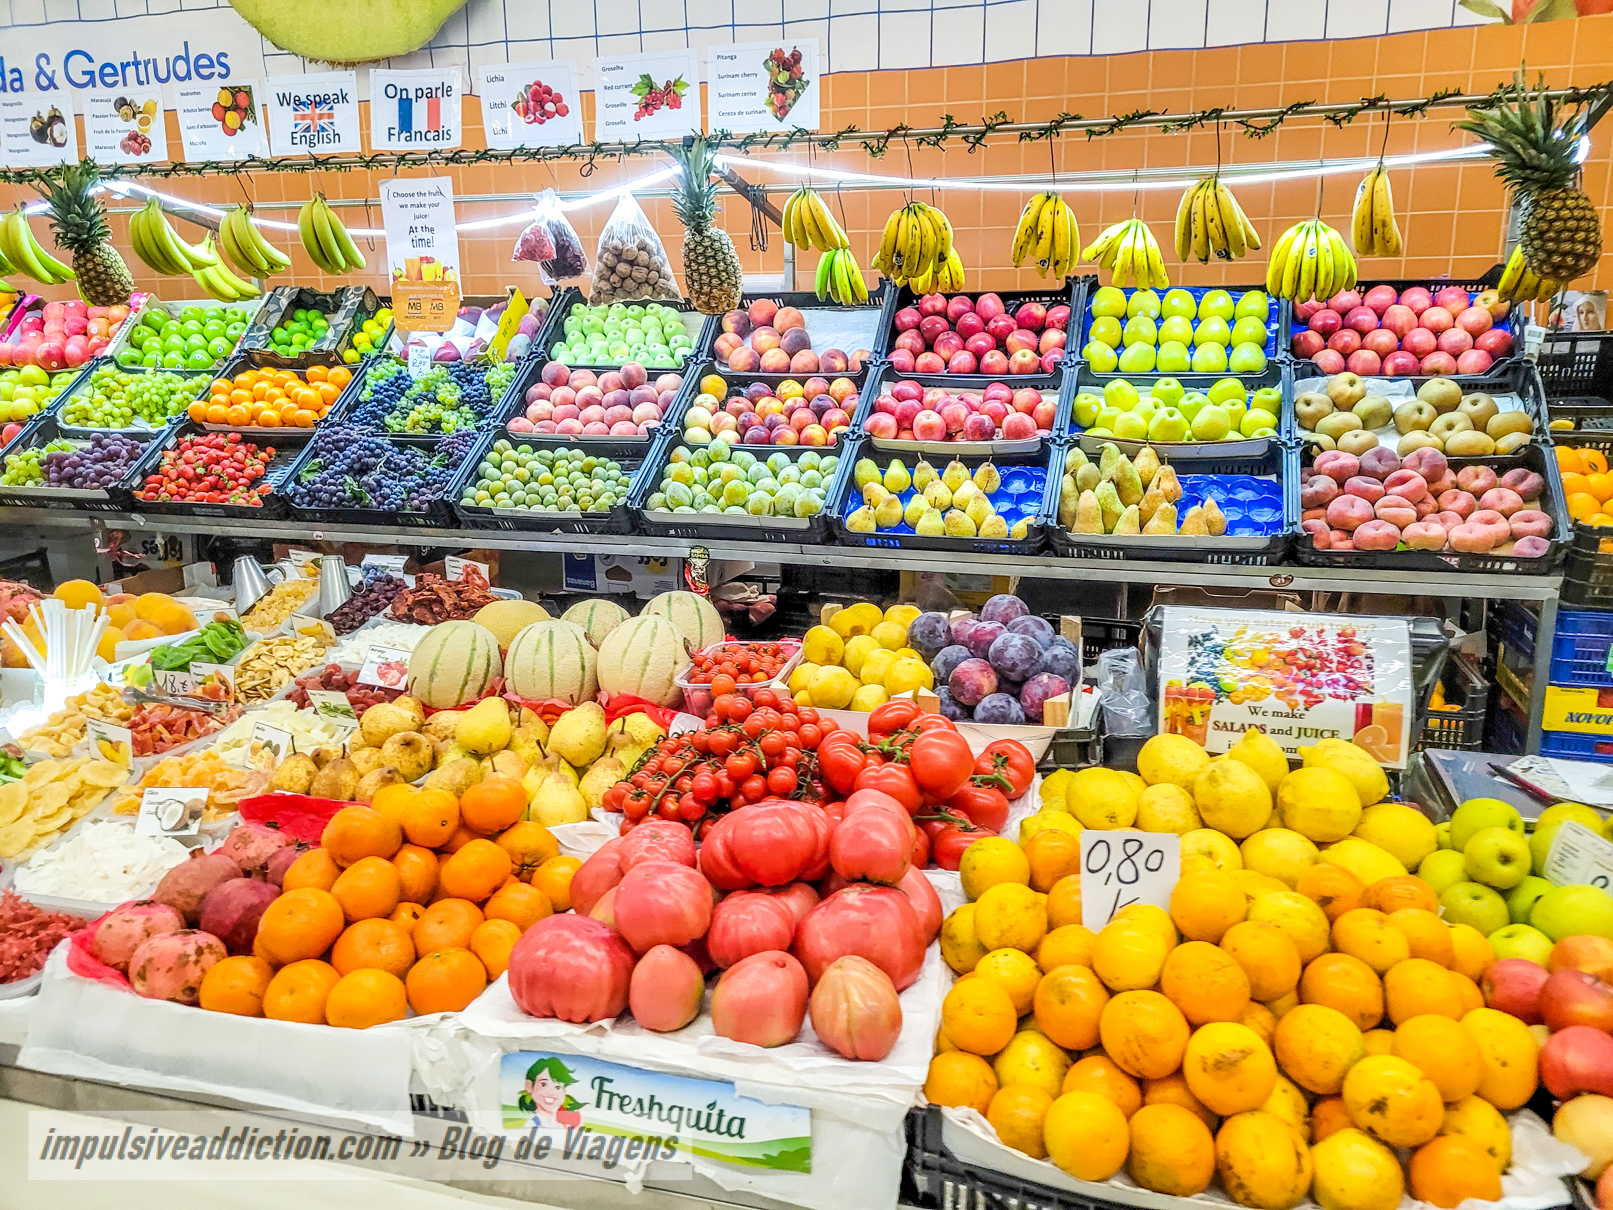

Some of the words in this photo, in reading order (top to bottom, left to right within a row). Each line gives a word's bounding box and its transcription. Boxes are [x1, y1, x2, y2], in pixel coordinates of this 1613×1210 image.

[35, 53, 59, 92] &
[63, 41, 231, 89] Gertrudes
[486, 75, 505, 83] Lichia
[276, 92, 301, 107] We
[305, 88, 350, 110] speak
[384, 83, 409, 100] On
[414, 82, 453, 103] parle
[489, 101, 507, 110] Litchi
[290, 129, 341, 149] English
[387, 125, 452, 143] Francais
[408, 225, 418, 235] At
[420, 225, 435, 235] the
[411, 235, 435, 249] time!
[407, 302, 422, 311] MB
[1225, 617, 1250, 627] you
[1253, 618, 1292, 628] eaten
[1295, 619, 1325, 629] fruit
[1329, 622, 1377, 634] today?
[1247, 705, 1269, 717] We
[1271, 707, 1306, 719] make
[1211, 720, 1267, 735] SALADS
[1269, 726, 1293, 736] and
[1294, 726, 1340, 740] JUICE
[1086, 838, 1164, 886] 0,80
[590, 1075, 747, 1140] Freshquita
